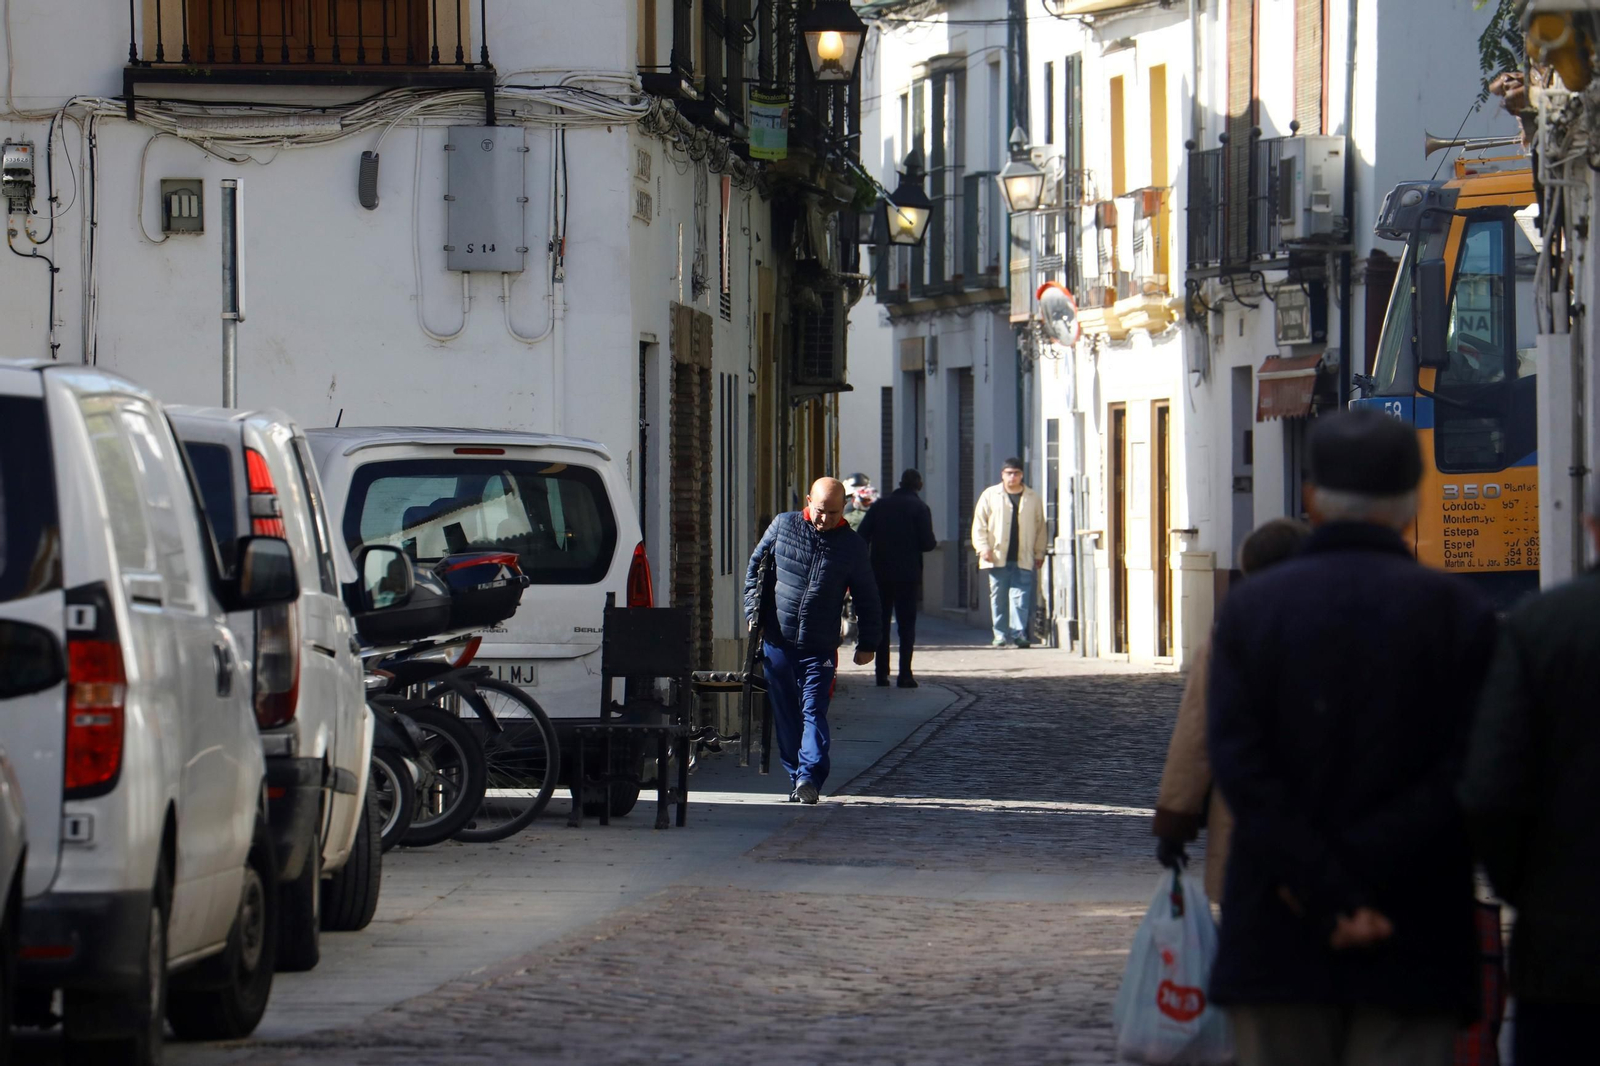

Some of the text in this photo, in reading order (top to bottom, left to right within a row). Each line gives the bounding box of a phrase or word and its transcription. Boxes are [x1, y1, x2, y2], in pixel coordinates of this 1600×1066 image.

[466, 243, 474, 254] S
[1442, 483, 1502, 500] 350
[1443, 527, 1480, 538] Estepa
